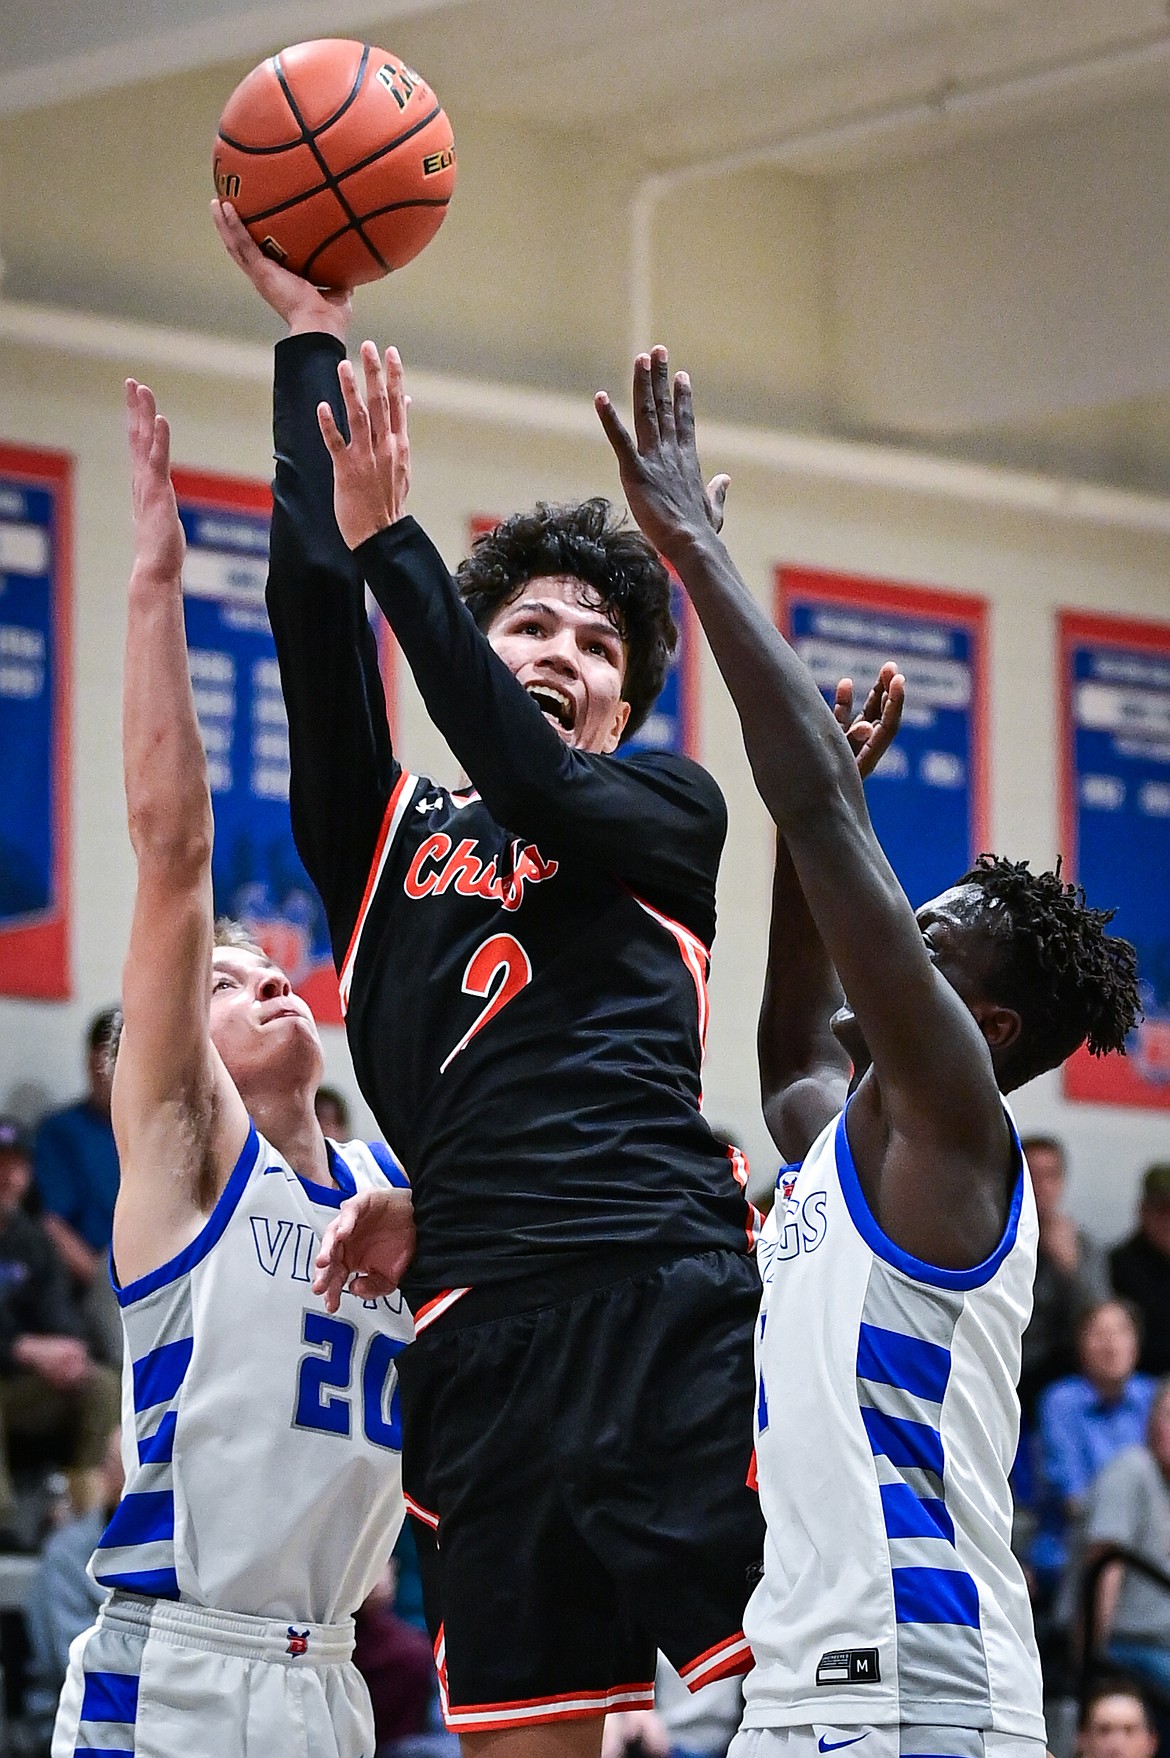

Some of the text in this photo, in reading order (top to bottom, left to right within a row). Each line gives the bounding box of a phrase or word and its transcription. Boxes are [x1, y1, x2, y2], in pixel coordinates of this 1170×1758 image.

[403, 832, 559, 912] Chifs
[290, 1307, 402, 1455] 20
[856, 1659, 869, 1673] M
